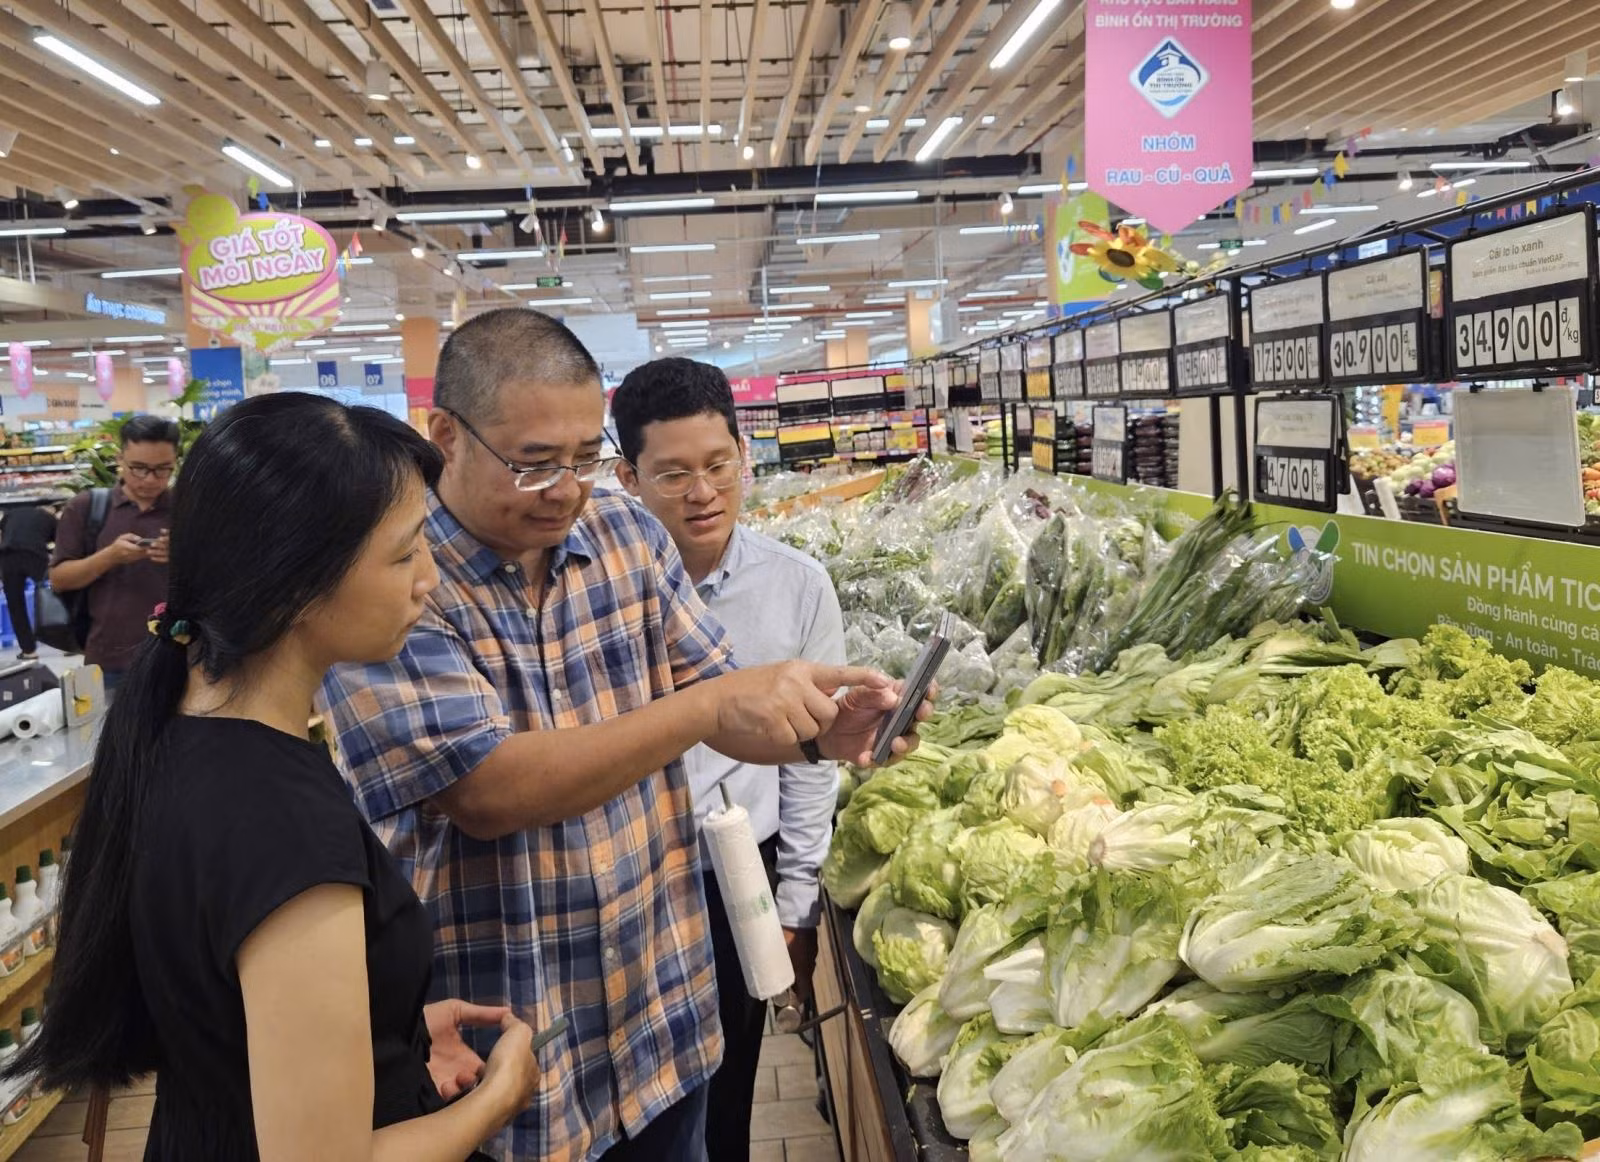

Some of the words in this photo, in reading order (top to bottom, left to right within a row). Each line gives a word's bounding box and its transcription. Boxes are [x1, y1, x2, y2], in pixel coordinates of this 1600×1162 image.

[1095, 13, 1128, 27] BÌNH
[1156, 15, 1178, 30] THỊ
[1181, 12, 1243, 27] TRƯỜNG
[1143, 133, 1195, 151] NHÓM
[1106, 169, 1142, 184] RAU
[1194, 162, 1232, 183] QUẢ
[211, 228, 259, 257] GIÁ
[259, 219, 304, 250] TỐT
[253, 249, 325, 281] NGÀY
[1459, 310, 1553, 357] 34.900
[1334, 333, 1399, 368] 30.900
[320, 374, 335, 386] 06
[366, 374, 380, 385] 07
[1351, 542, 1379, 568] TIN
[1382, 547, 1435, 581] CHỌN
[1440, 552, 1481, 588] SẢN
[1487, 561, 1554, 602] PHẨM
[1467, 596, 1501, 621] Đồng
[1504, 604, 1538, 627] hành
[1541, 614, 1577, 640] cùng
[1506, 632, 1523, 650] An
[1527, 636, 1558, 659] toàn
